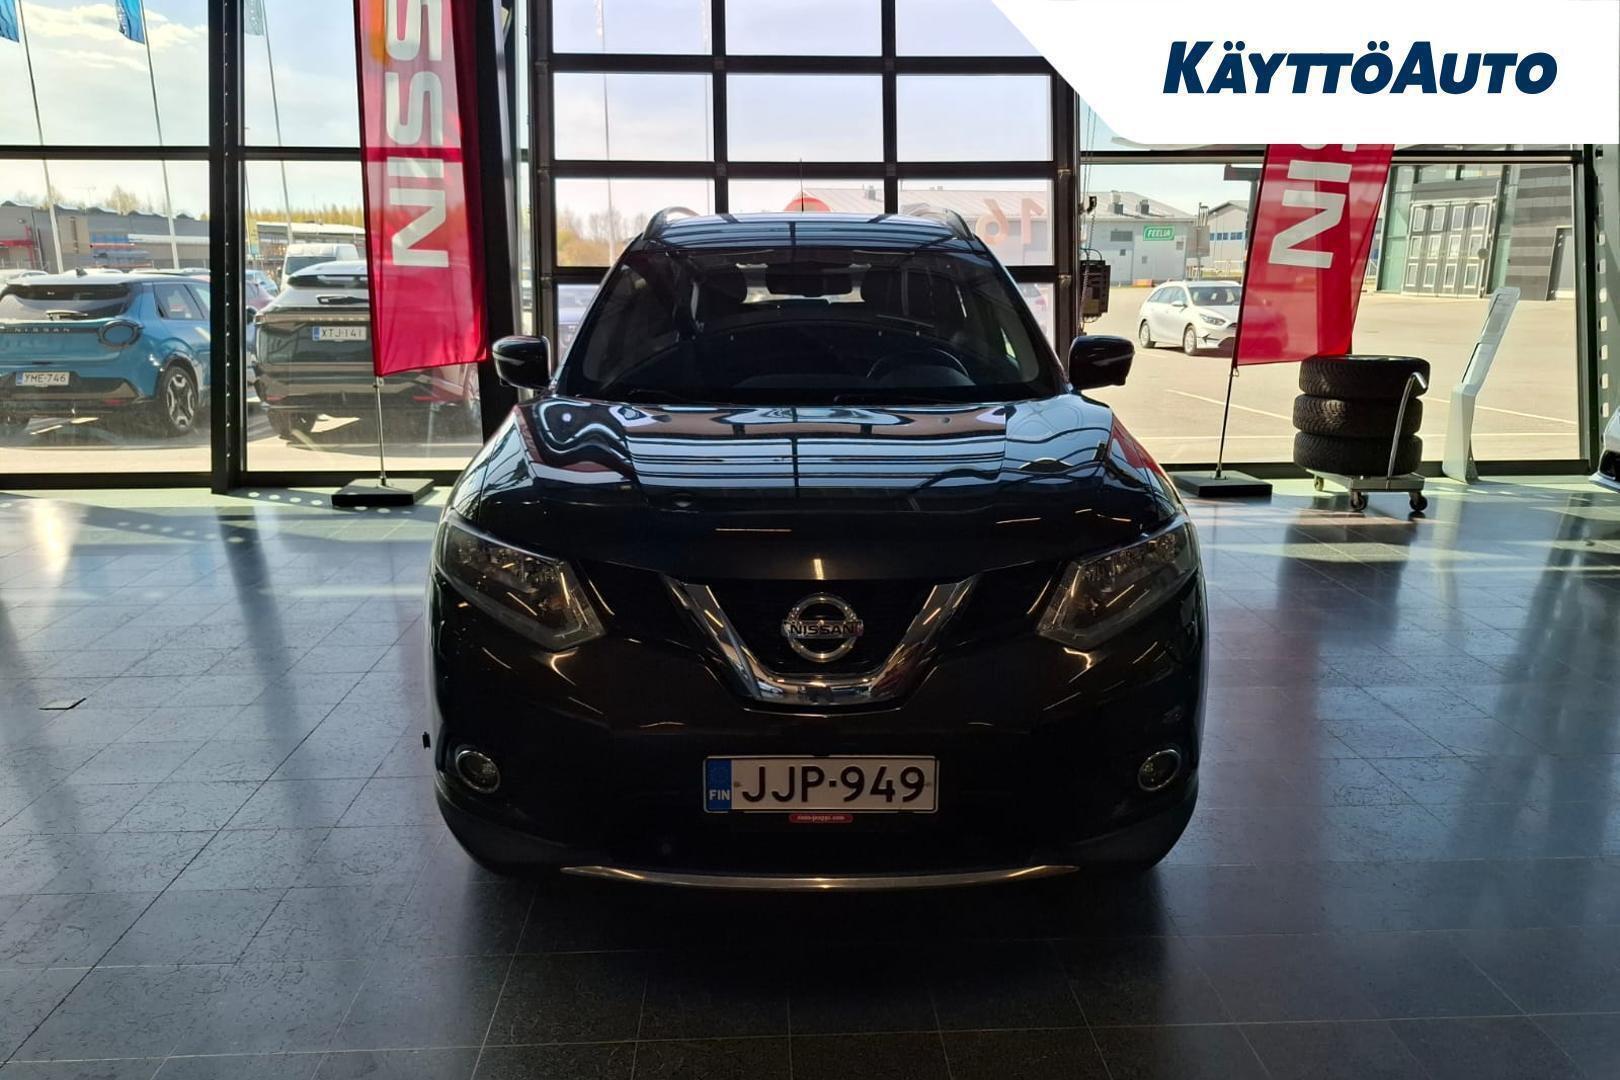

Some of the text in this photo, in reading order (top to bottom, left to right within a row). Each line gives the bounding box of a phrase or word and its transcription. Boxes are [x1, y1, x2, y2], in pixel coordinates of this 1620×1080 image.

[384, 0, 449, 267] NISS
[1268, 144, 1357, 268] NI
[790, 623, 856, 636] NISSAN
[709, 789, 731, 800] FIN
[742, 765, 926, 803] JJP-949
